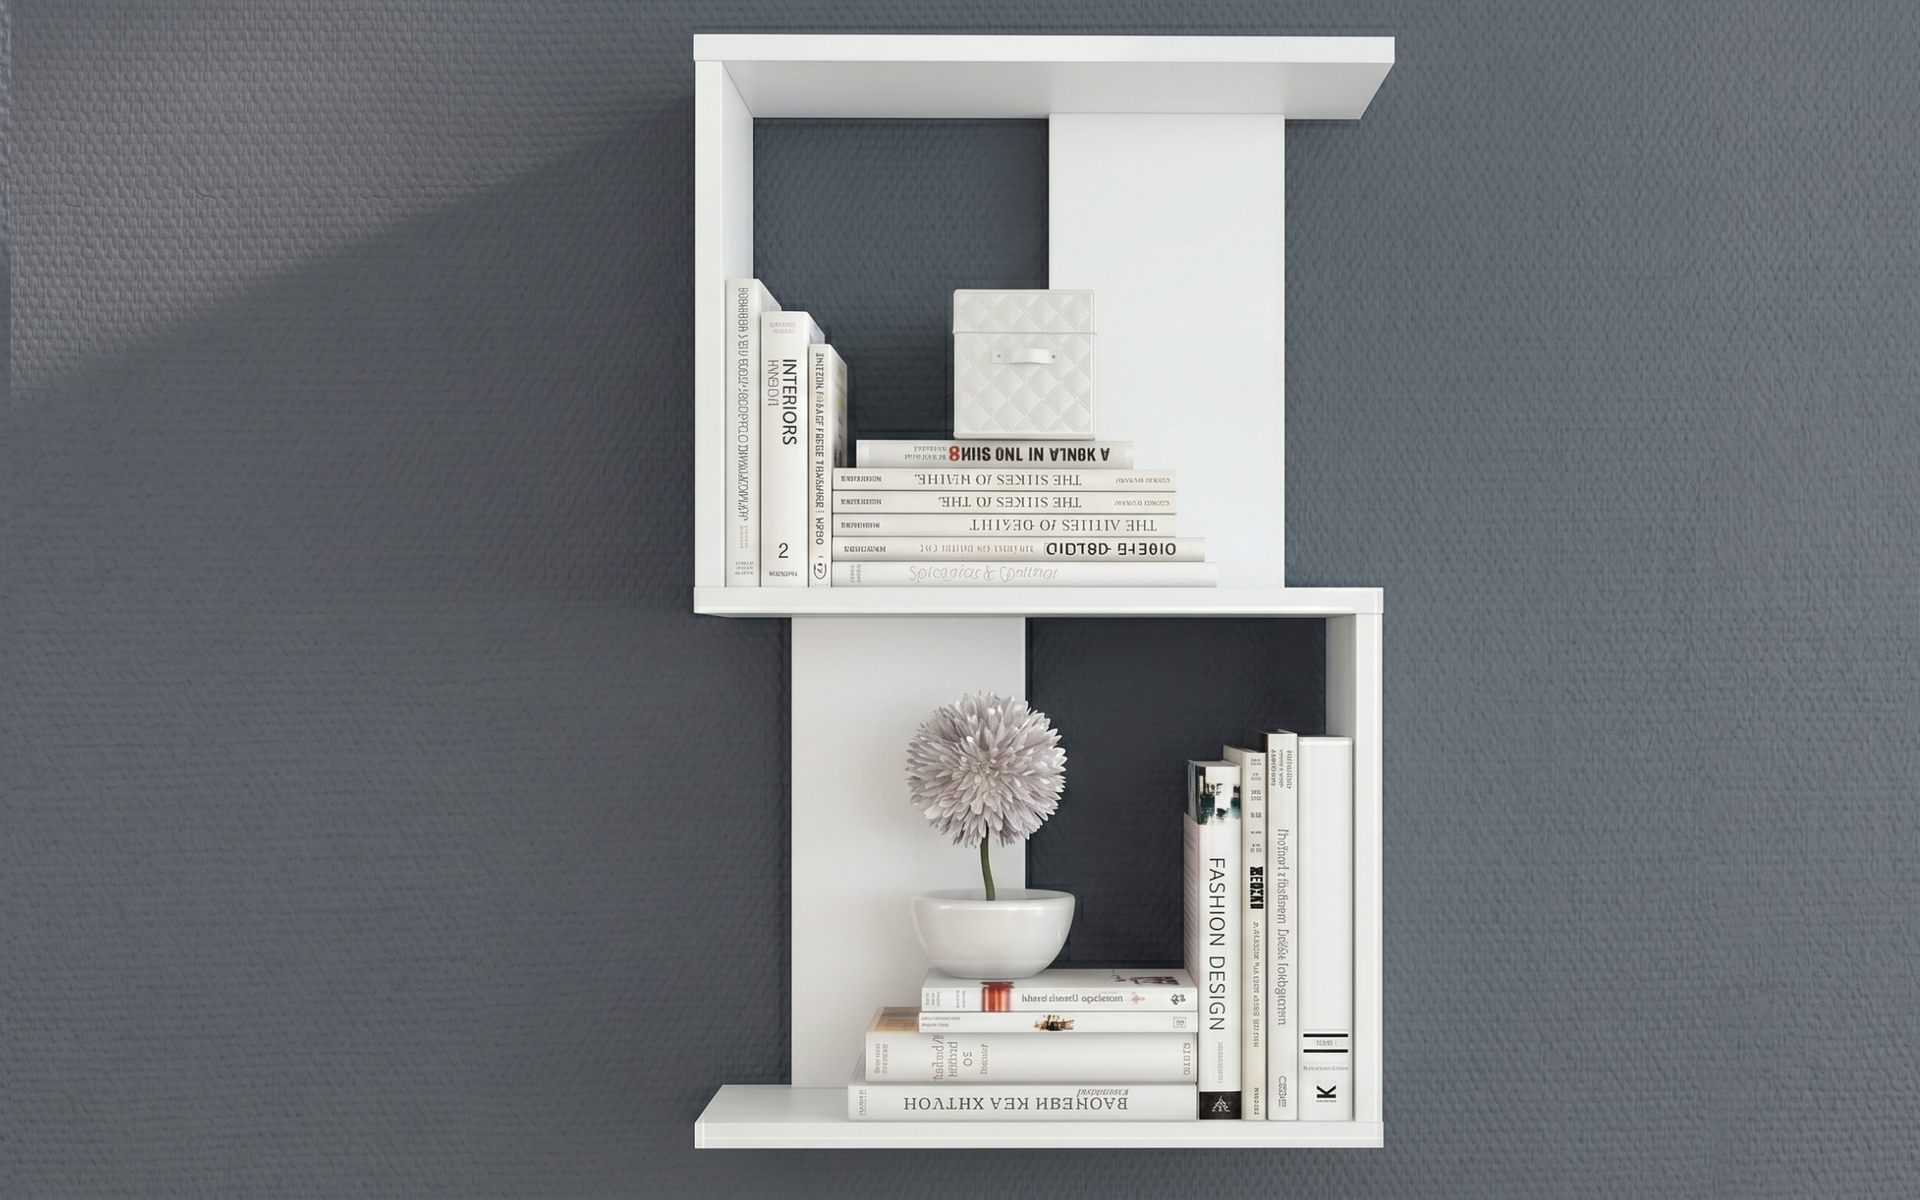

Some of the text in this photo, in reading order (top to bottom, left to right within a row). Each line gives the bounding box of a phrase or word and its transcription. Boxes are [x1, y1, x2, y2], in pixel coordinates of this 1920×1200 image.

[782, 359, 797, 445] INTERIORS
[778, 542, 789, 559] 2
[1208, 858, 1226, 1030] FASHION DESIGN
[1316, 1085, 1337, 1099] K
